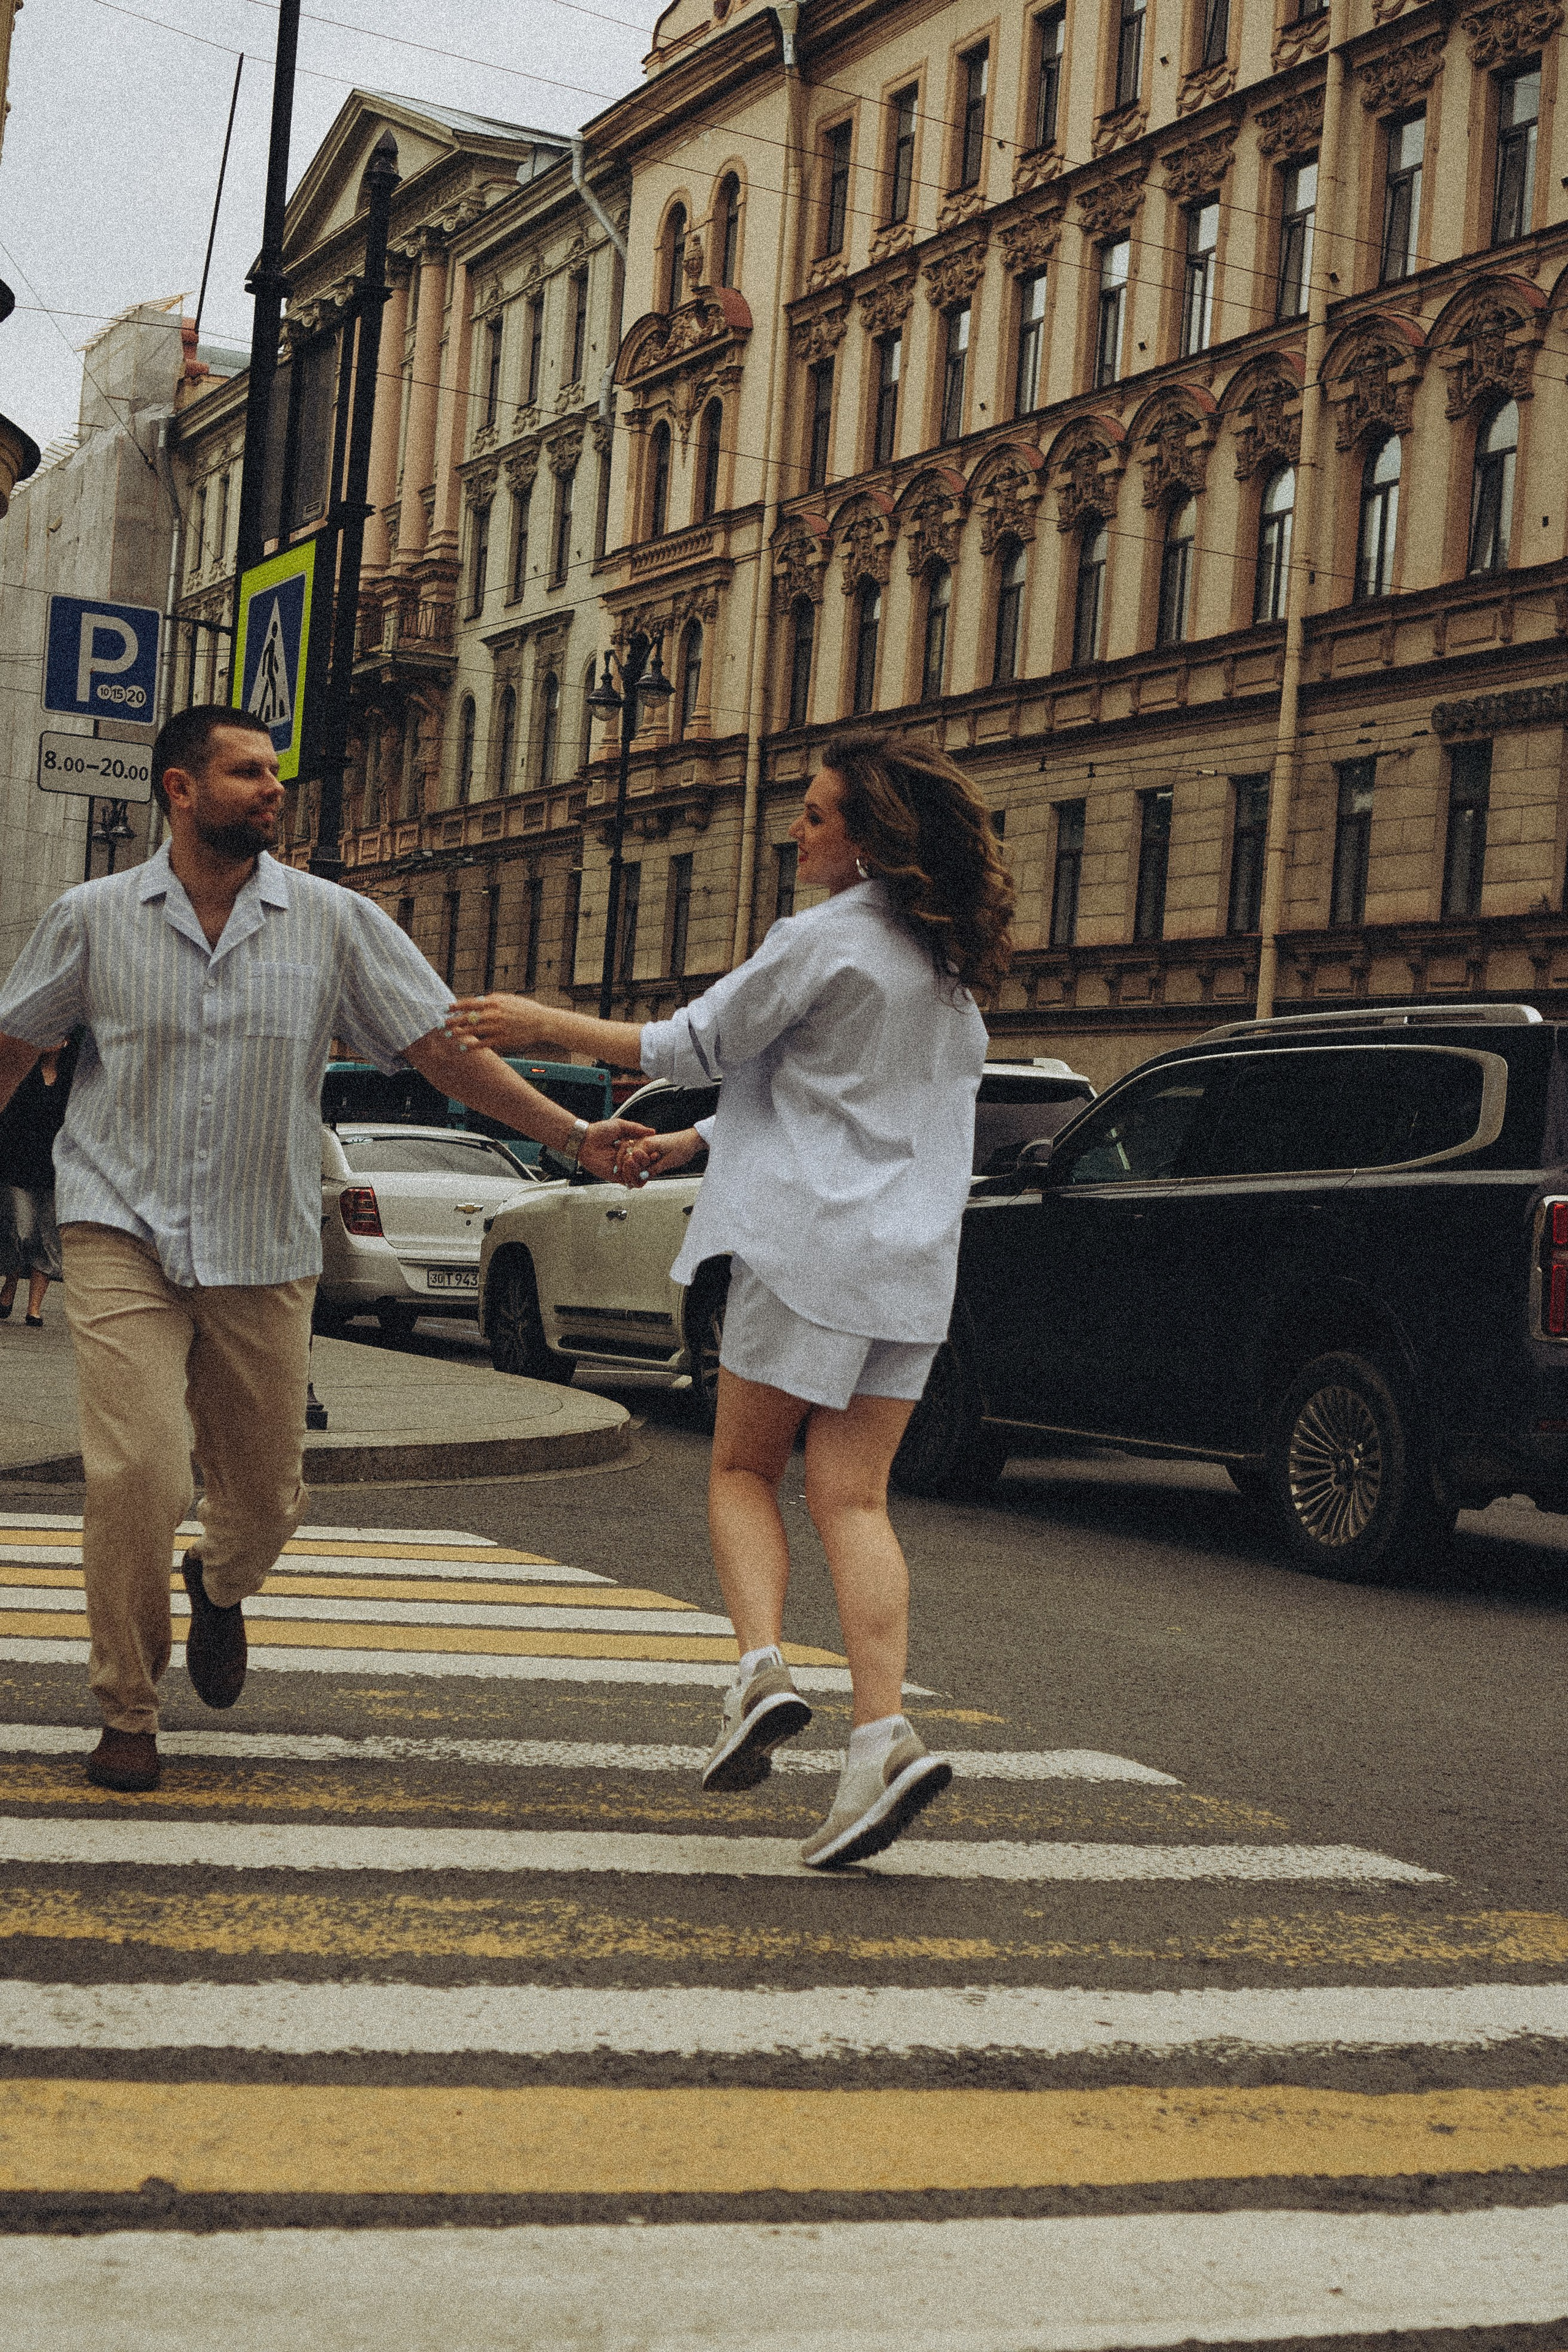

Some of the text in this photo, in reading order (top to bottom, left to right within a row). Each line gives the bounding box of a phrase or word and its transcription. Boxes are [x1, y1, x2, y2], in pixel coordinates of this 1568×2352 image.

[77, 612, 138, 702] P
[100, 688, 145, 704] 10 15 20
[431, 1273, 443, 1284] 30
